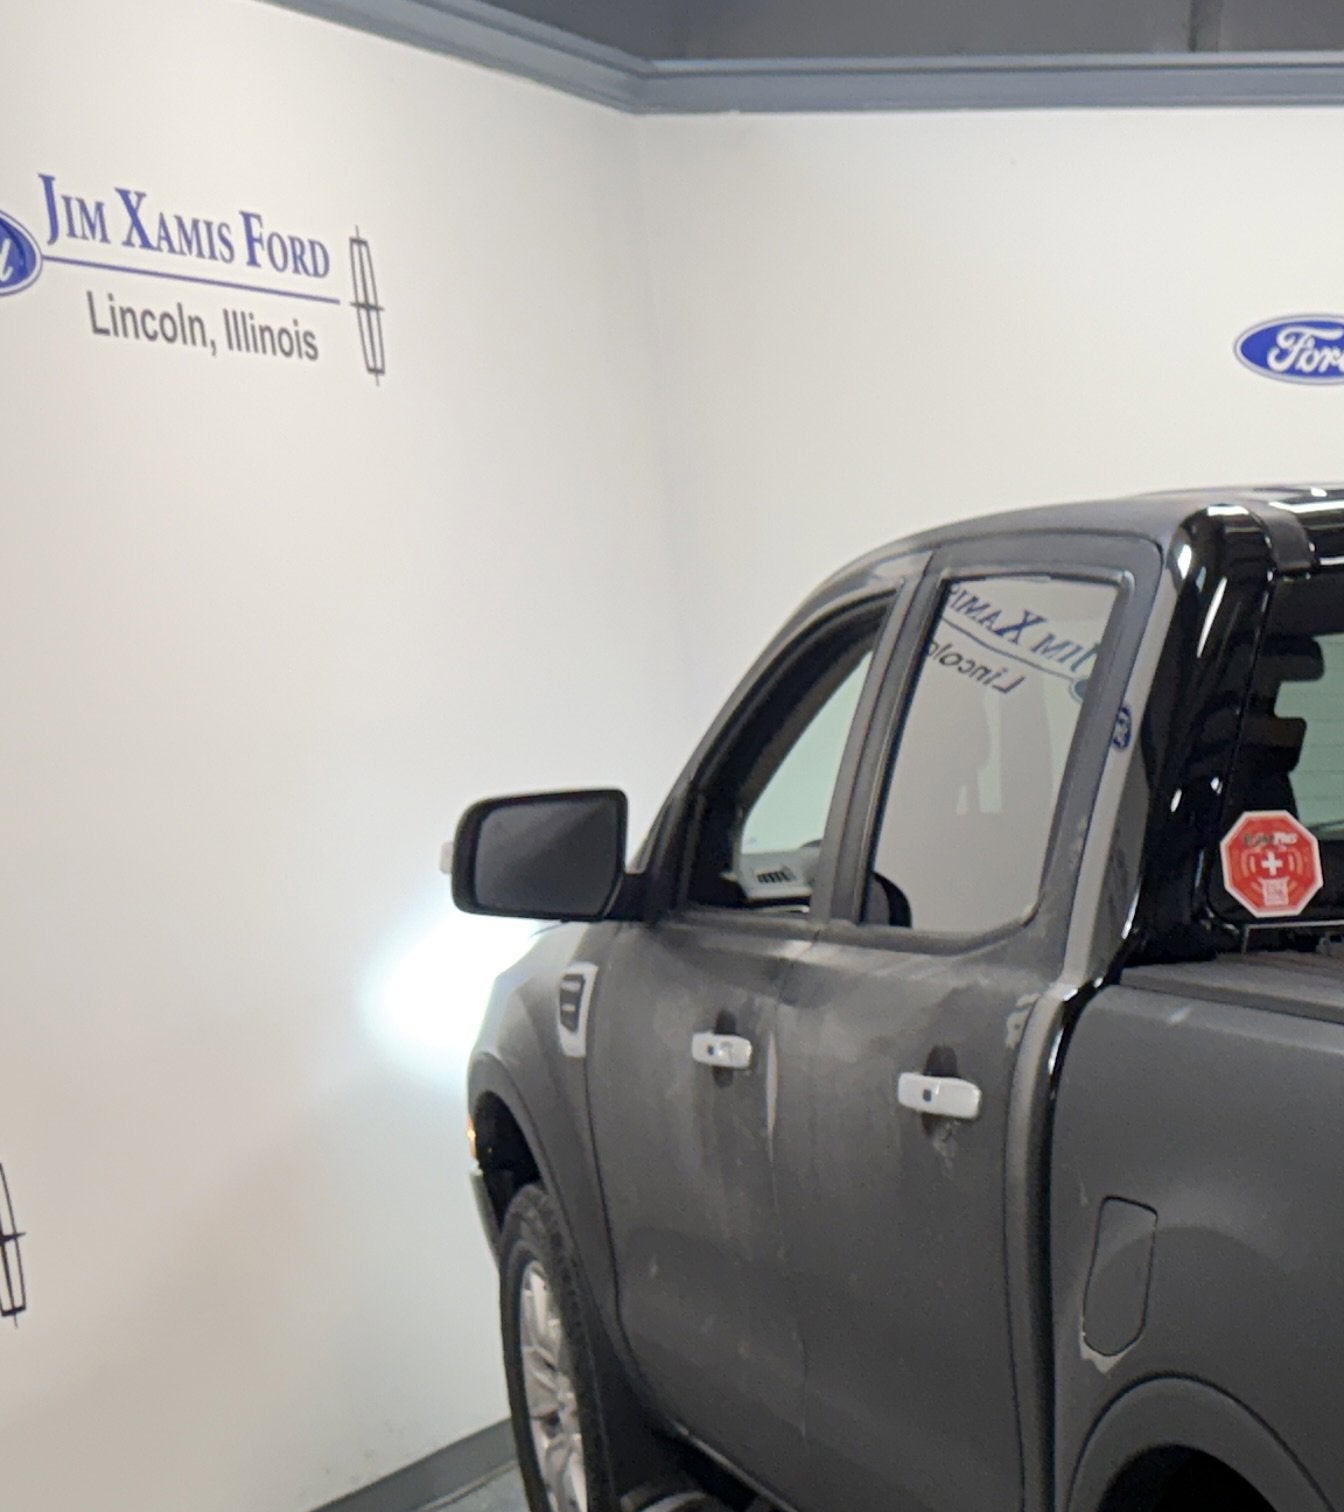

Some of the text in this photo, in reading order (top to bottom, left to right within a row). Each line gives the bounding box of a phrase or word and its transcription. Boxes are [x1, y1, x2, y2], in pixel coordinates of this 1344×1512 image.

[38, 173, 330, 278] JIM XAMIS FORD
[86, 290, 319, 361] Lincoln, Illinois
